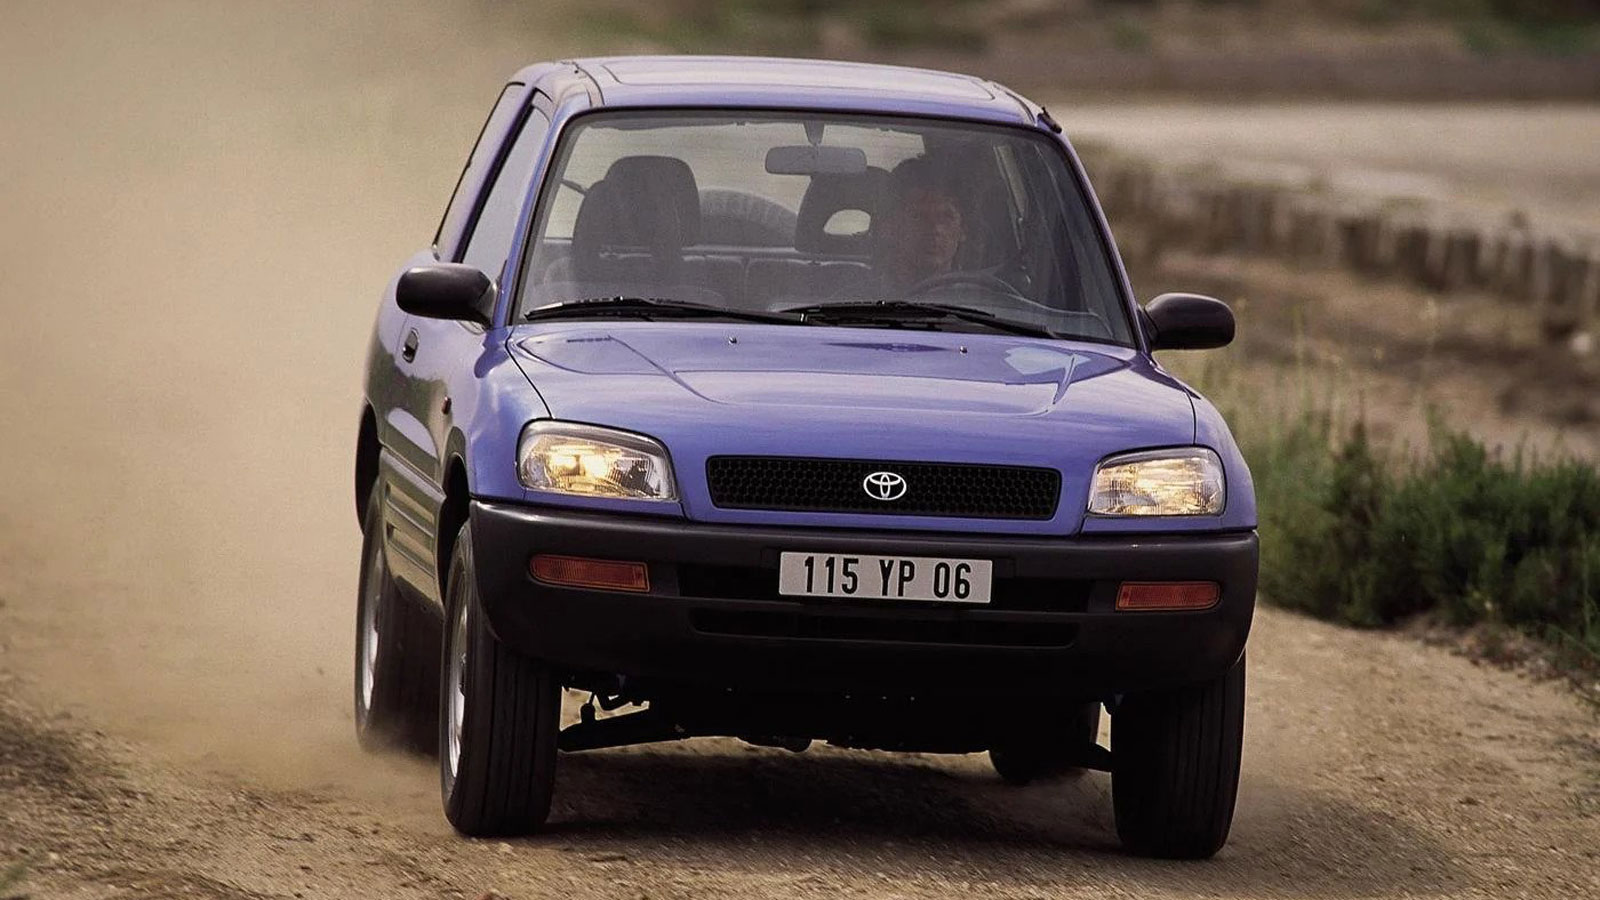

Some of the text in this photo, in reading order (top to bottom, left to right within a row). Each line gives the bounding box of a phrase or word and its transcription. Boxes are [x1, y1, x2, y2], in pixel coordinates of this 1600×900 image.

[804, 556, 971, 599] 115 YP 06
